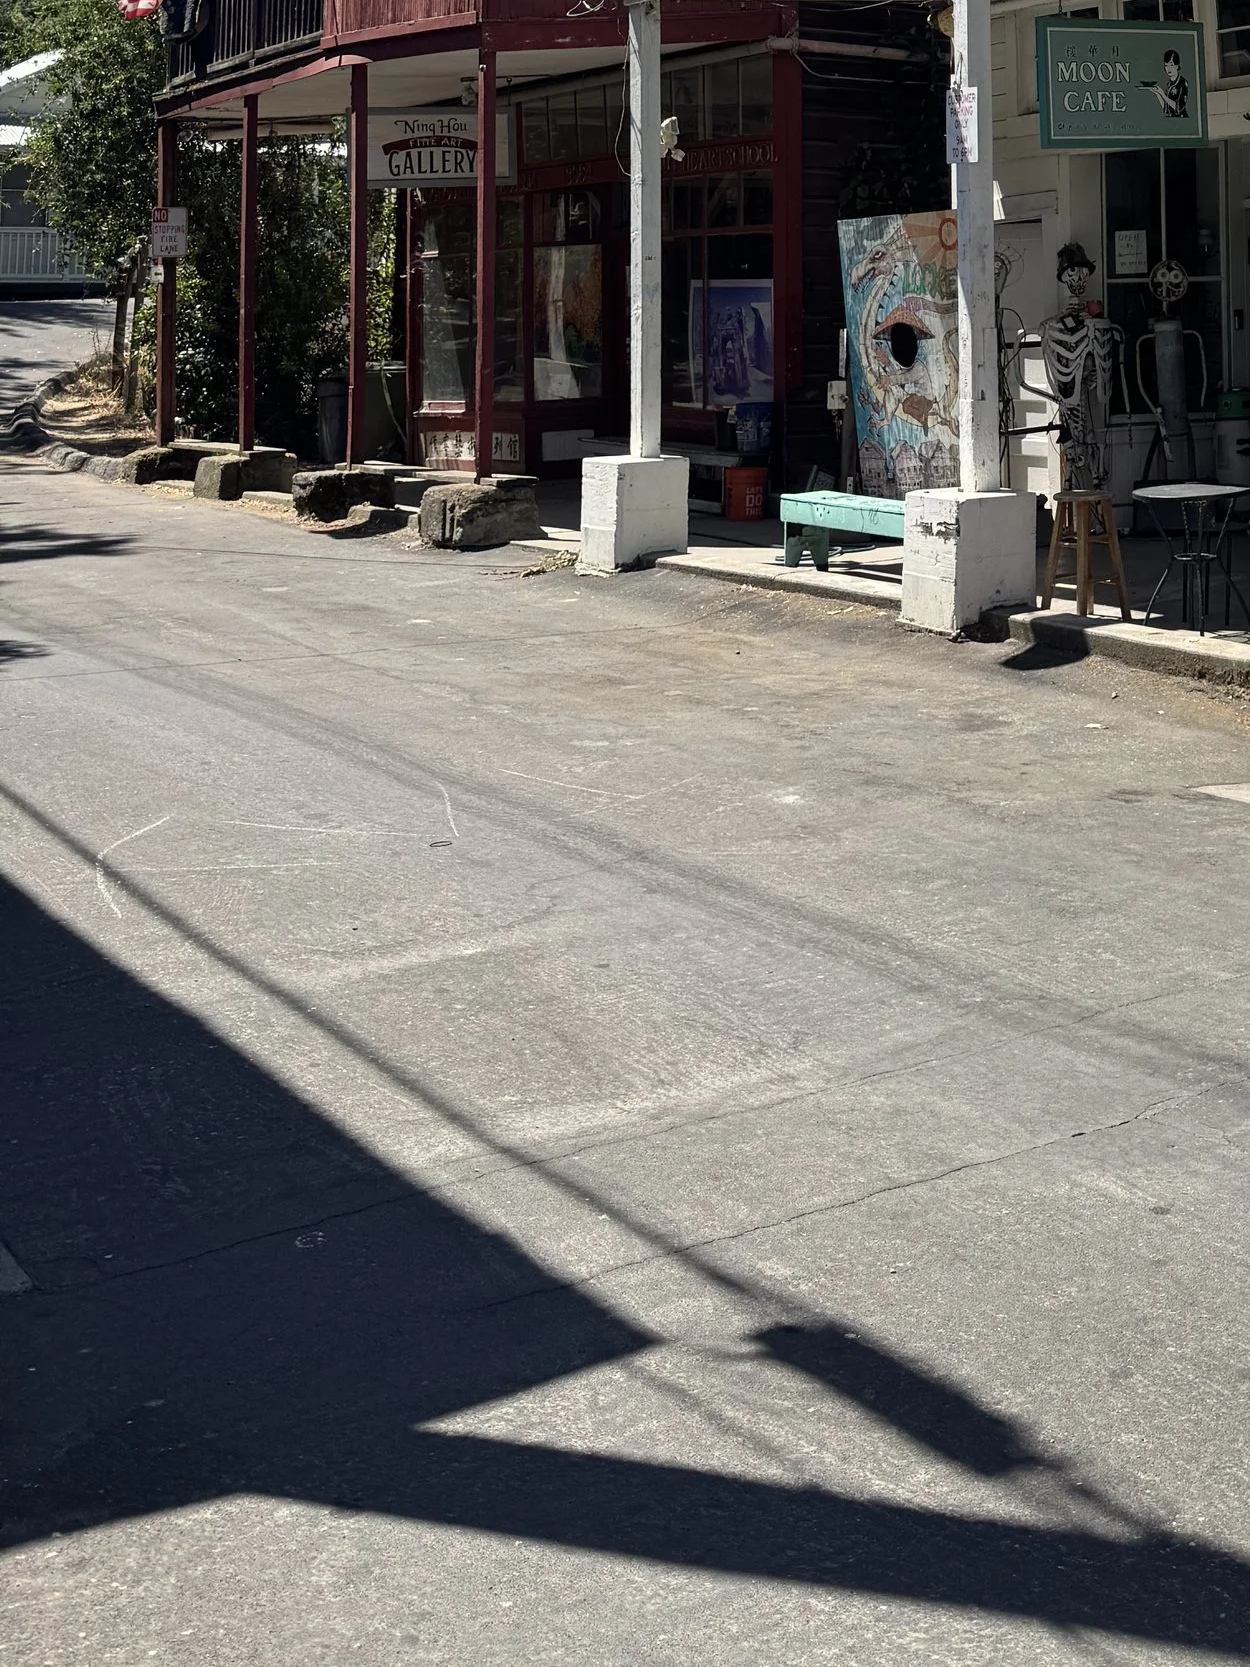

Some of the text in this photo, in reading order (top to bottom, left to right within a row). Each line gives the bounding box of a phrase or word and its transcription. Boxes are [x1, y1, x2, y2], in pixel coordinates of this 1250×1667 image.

[1057, 60, 1131, 84] MOON
[1062, 90, 1128, 114] CAFE
[394, 117, 468, 137] Ning Hou
[441, 137, 463, 148] ART
[388, 149, 477, 177] GALLERY
[727, 141, 779, 168] SCHOOL
[154, 209, 167, 221] NO
[155, 225, 184, 234] STOPPING
[746, 494, 763, 507] DO
